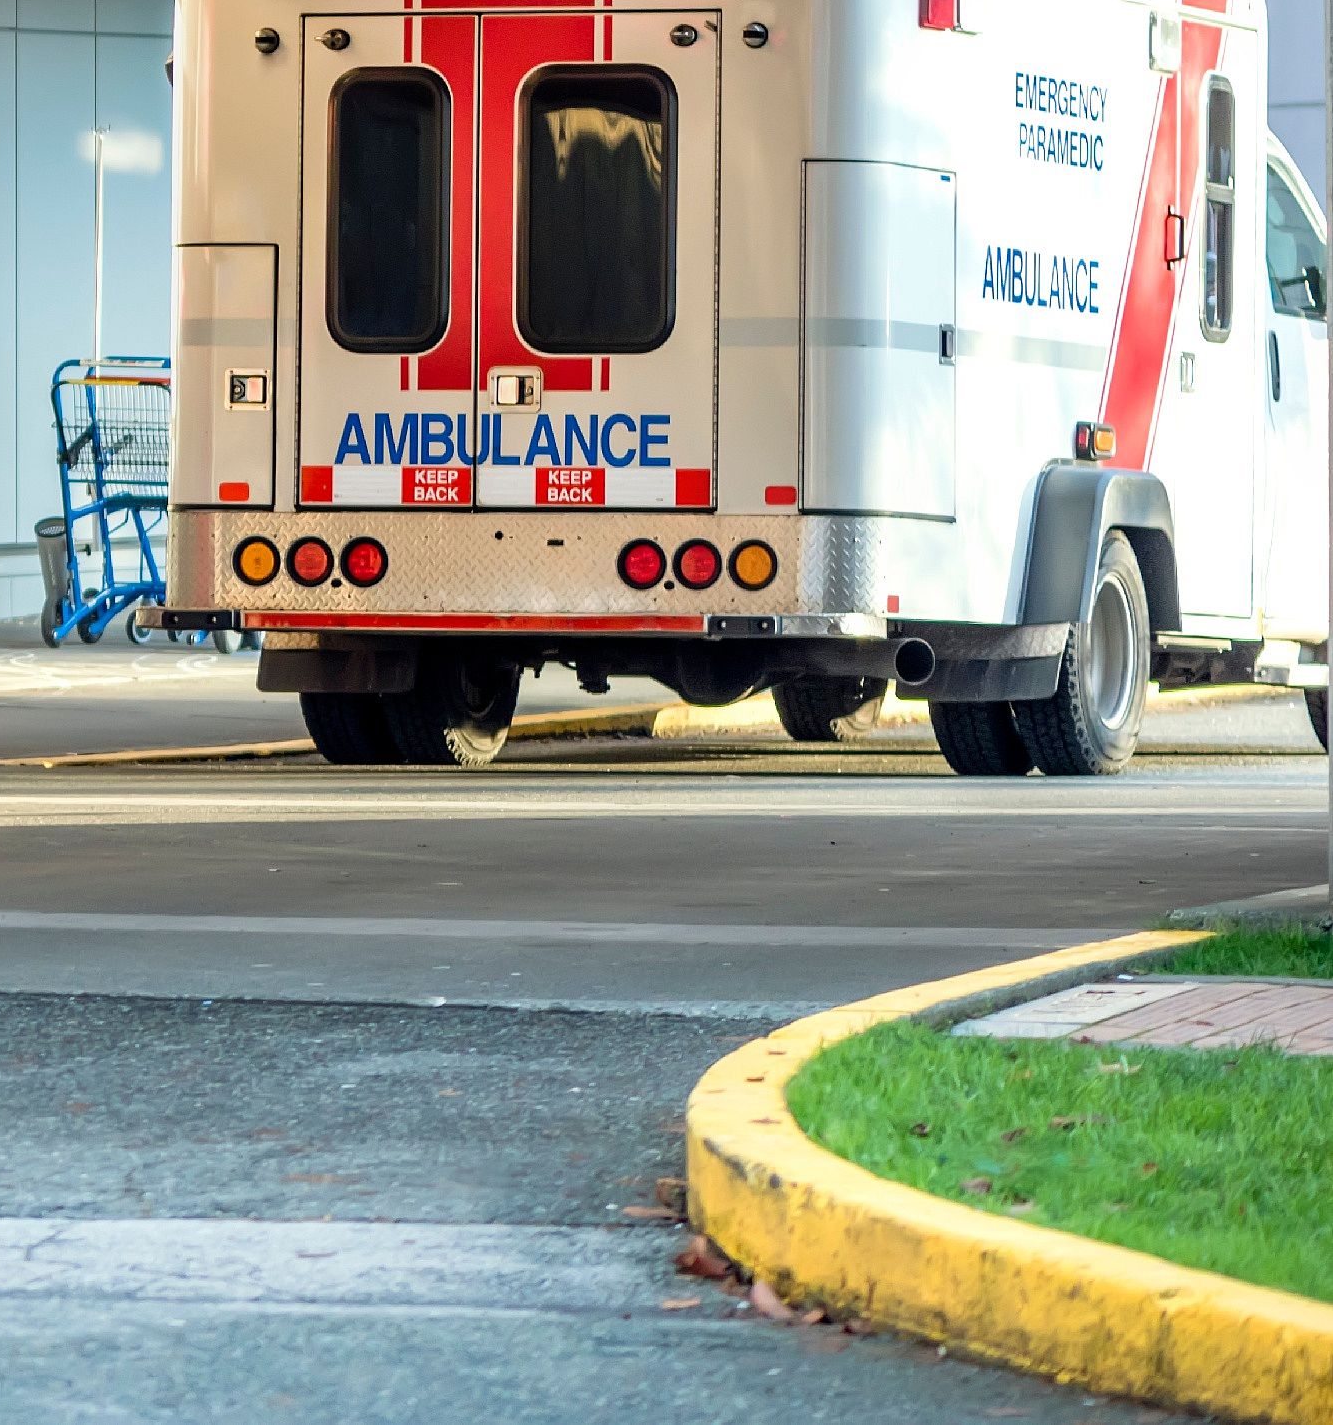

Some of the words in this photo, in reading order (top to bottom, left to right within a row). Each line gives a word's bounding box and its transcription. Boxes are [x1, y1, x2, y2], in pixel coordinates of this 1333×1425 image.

[1015, 71, 1108, 123] EMERGENCY
[1019, 122, 1104, 172] PARAMEDIC
[982, 245, 1099, 314] AMBULANCE
[335, 413, 671, 467] AMBULANCE
[414, 470, 459, 484] KEEP
[548, 470, 593, 485] KEEP
[414, 486, 459, 502] BACK
[547, 487, 593, 503] BACK
